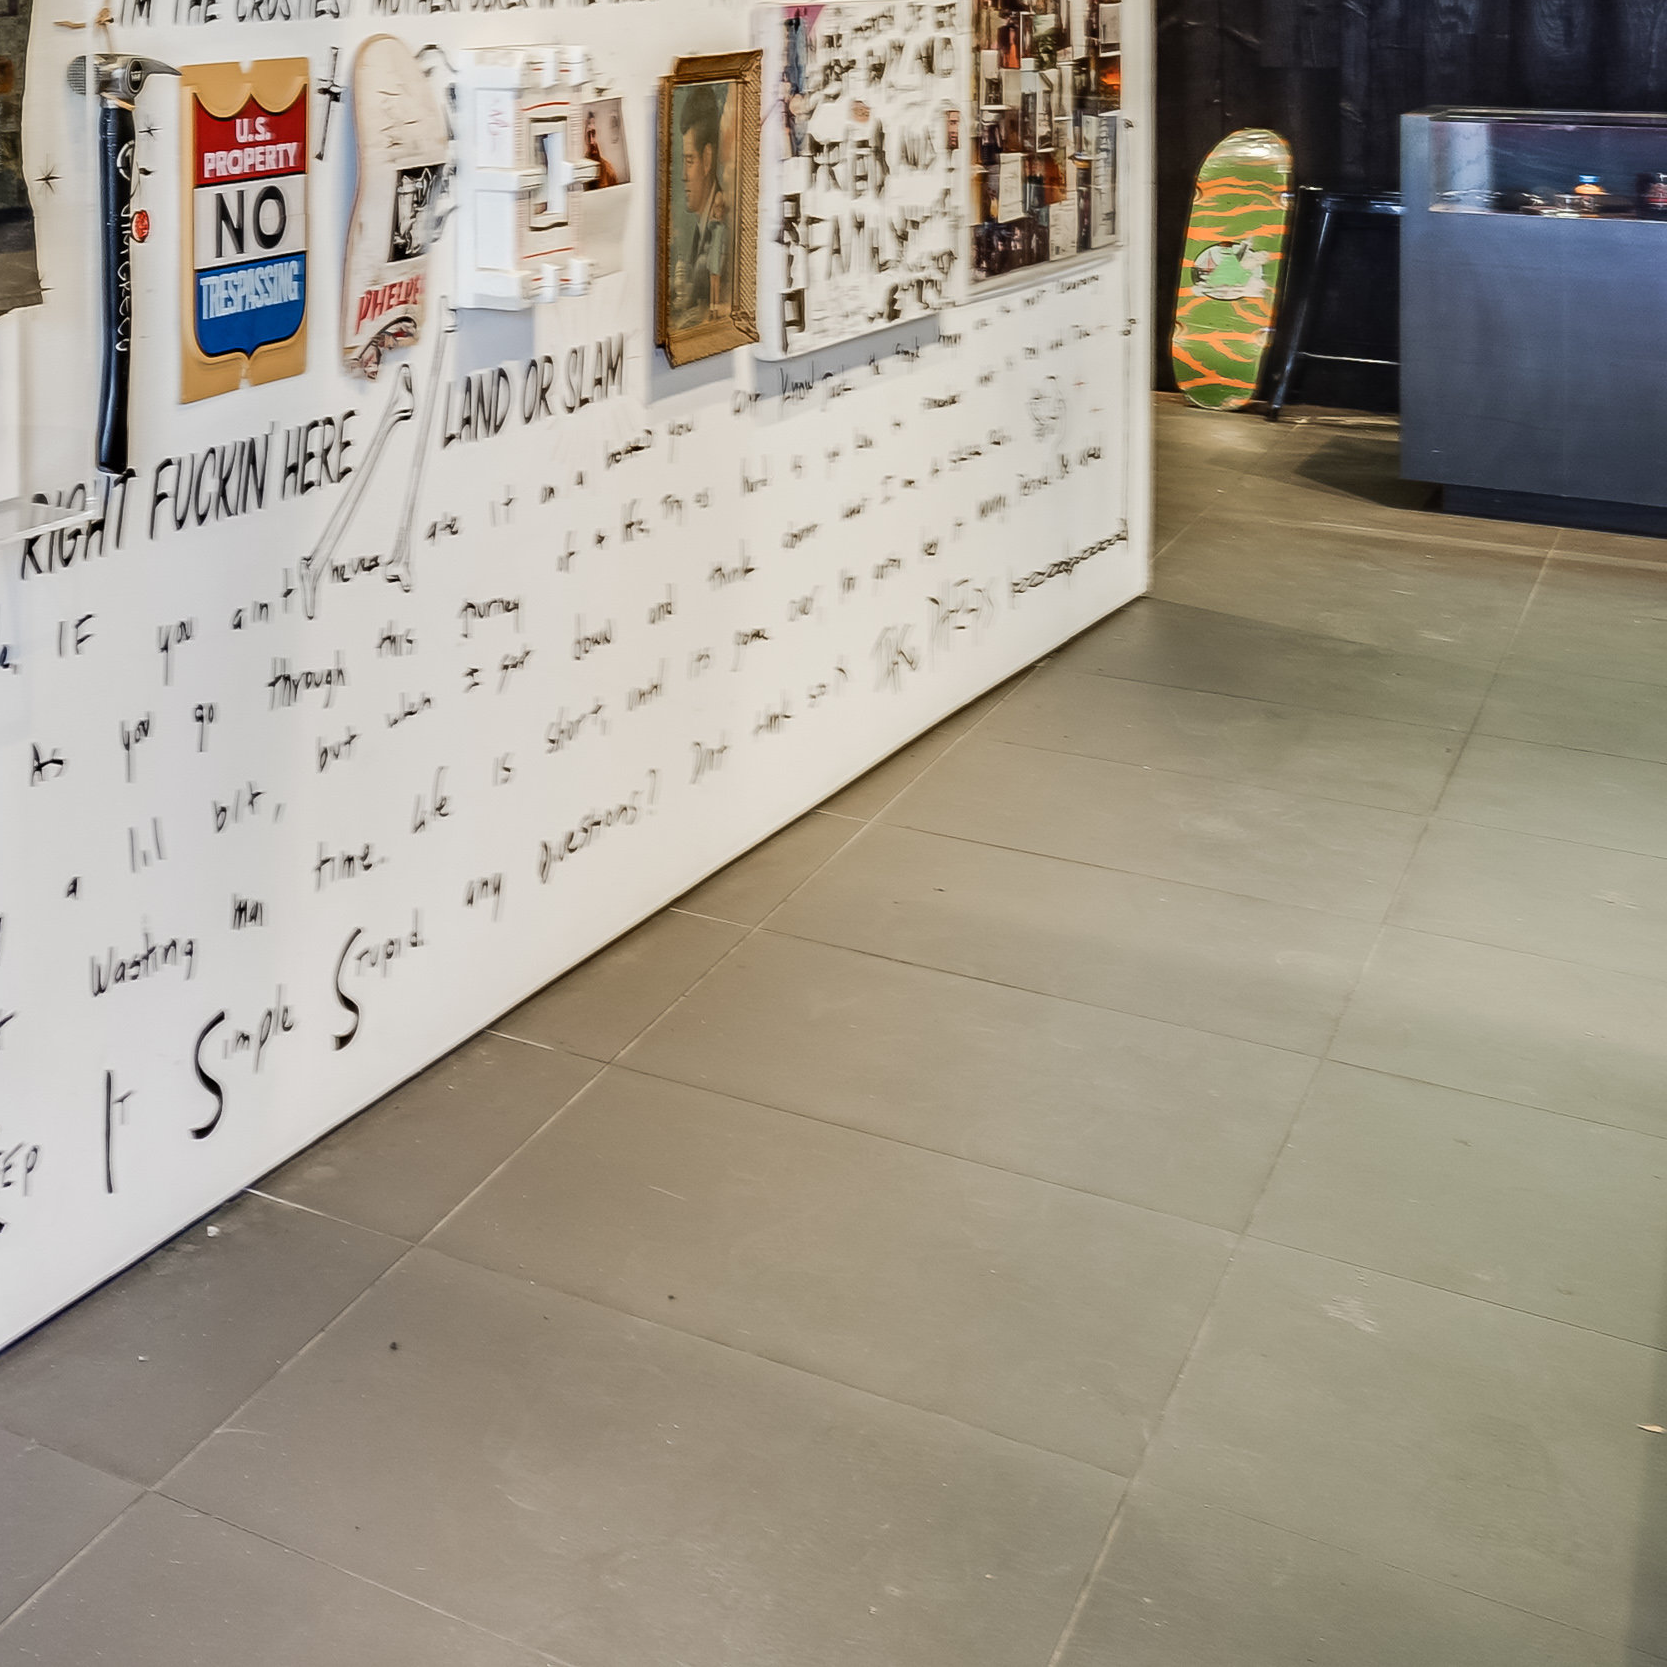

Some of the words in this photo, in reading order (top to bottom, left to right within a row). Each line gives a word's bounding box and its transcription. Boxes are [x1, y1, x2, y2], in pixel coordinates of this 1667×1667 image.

[235, 116, 272, 144] U.S.
[203, 142, 301, 179] PROPERTY
[215, 185, 287, 259] NO
[199, 260, 301, 320] TRESPASSING
[20, 466, 138, 581] RIGHT
[280, 409, 360, 502] HERE
[441, 367, 515, 450] LAND
[521, 356, 557, 425] OR
[564, 336, 626, 415] SLAM
